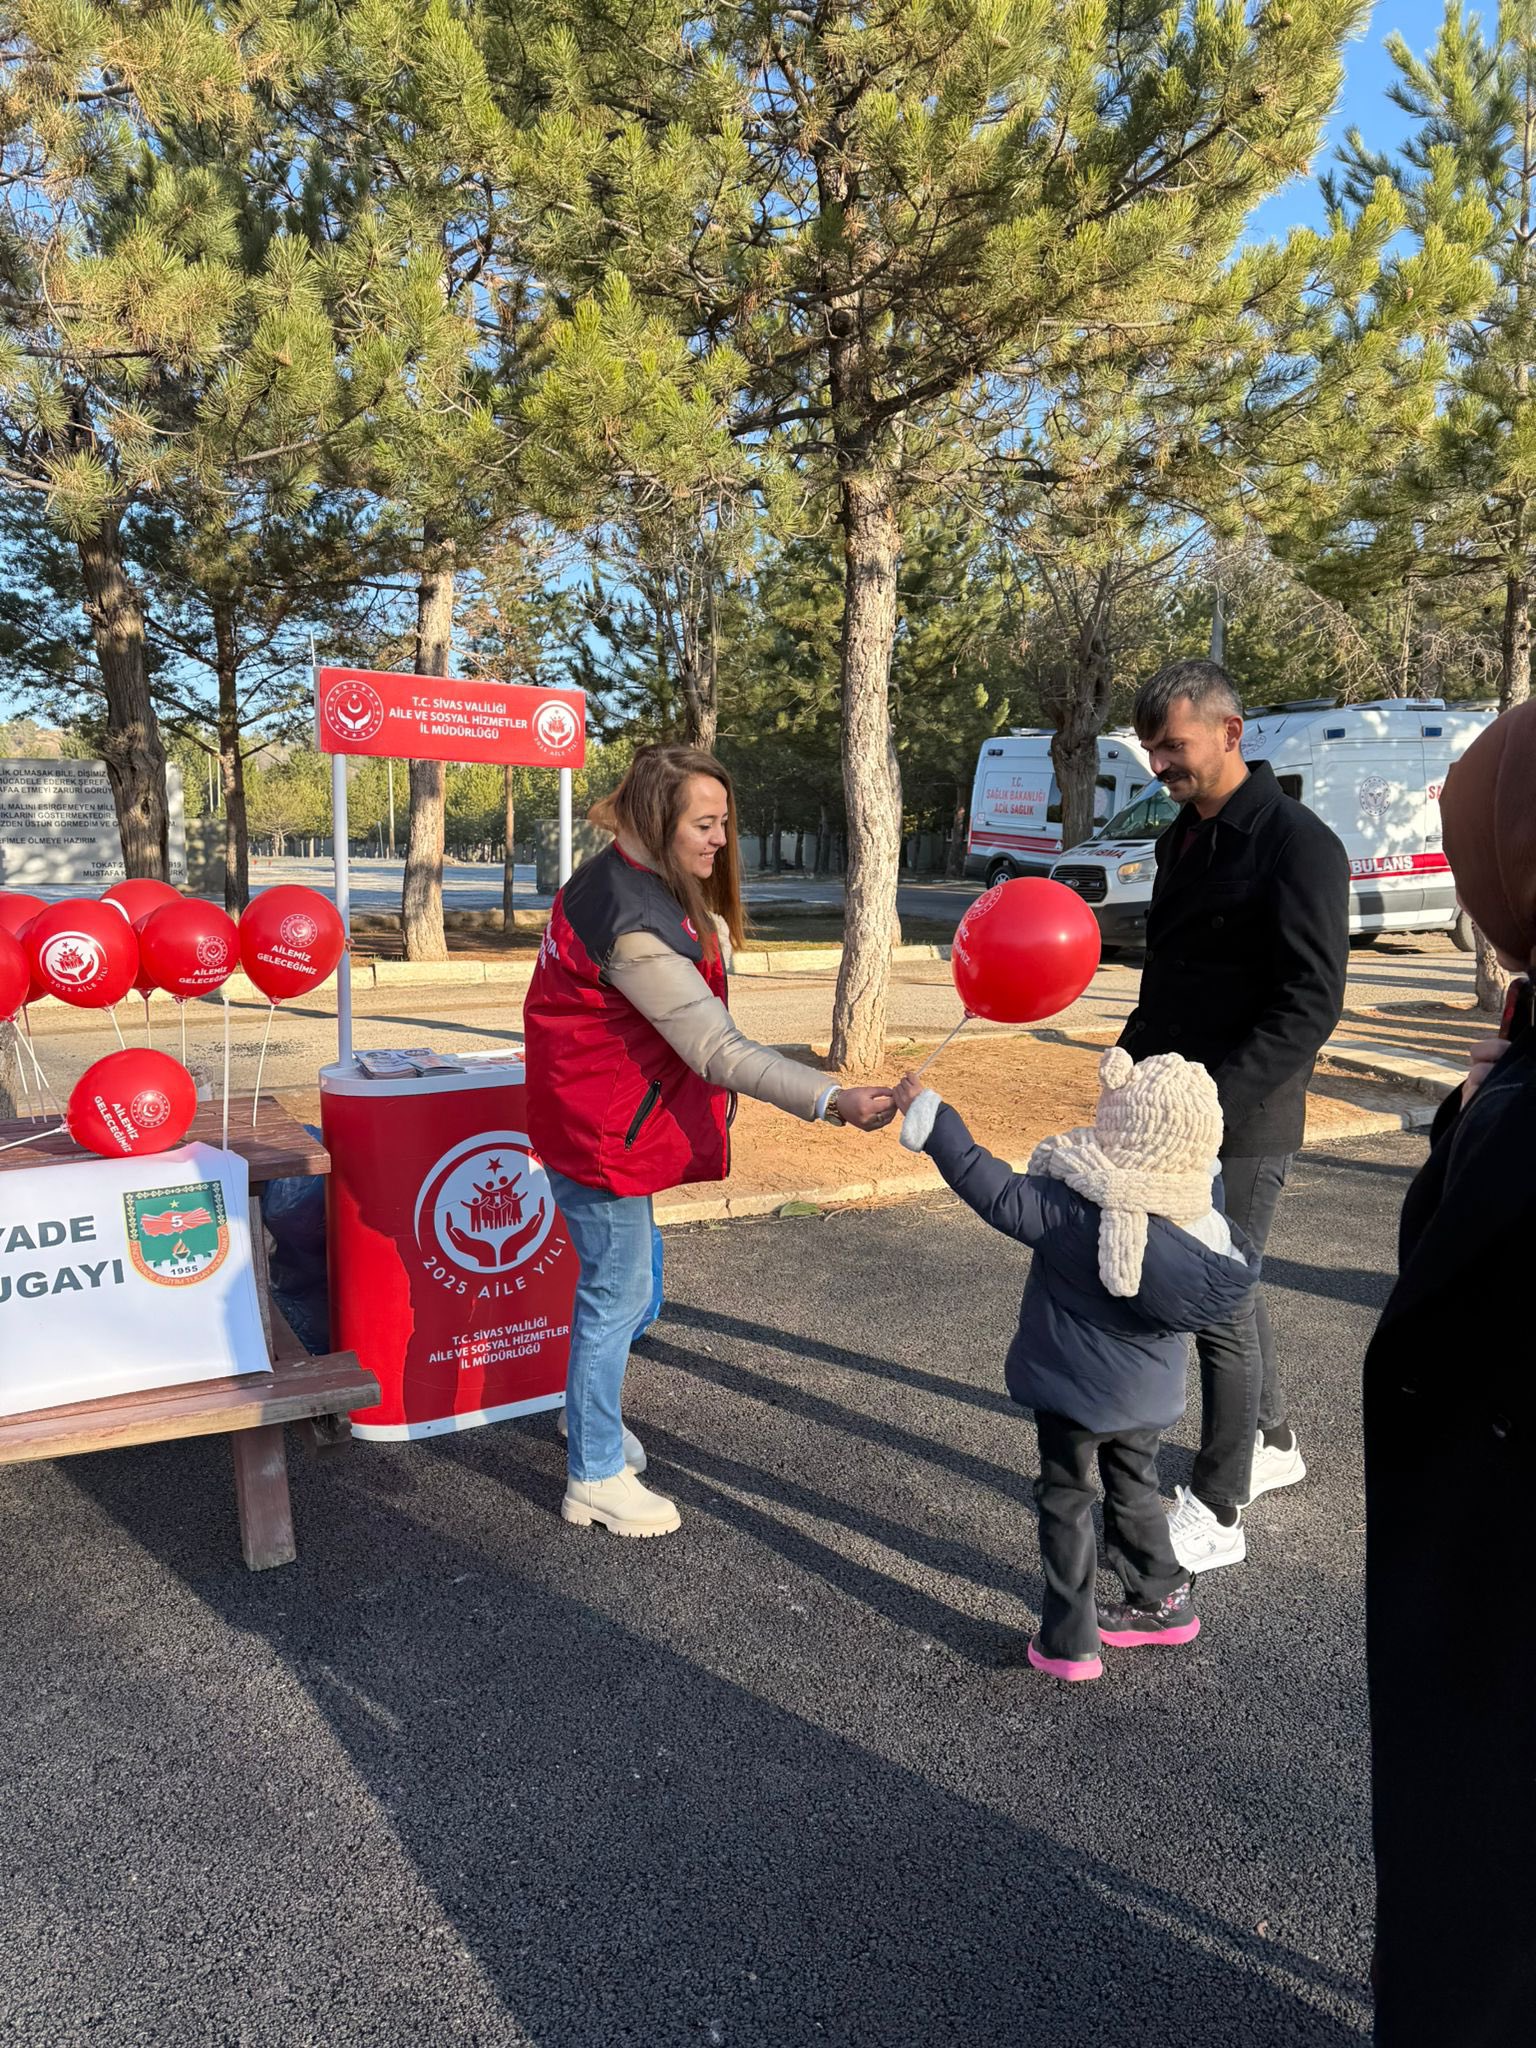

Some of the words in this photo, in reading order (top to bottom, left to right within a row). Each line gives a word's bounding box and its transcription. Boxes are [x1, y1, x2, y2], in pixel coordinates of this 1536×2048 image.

[412, 696, 430, 708] T.C.
[433, 698, 462, 711] SİVAS
[465, 700, 507, 715] VALİLİĞİ
[389, 706, 412, 719] AİLE
[414, 709, 428, 720] VE
[431, 712, 469, 724] SOSYAL
[472, 714, 527, 729] HİZMETLER
[420, 723, 429, 734] İL
[431, 723, 499, 740] MÜDÜRLÜĞÜ
[256, 952, 318, 975] GELECEĞİMİZ
[271, 944, 312, 962] AİLEMİZ
[193, 966, 228, 976] AİLEMİZ
[94, 1095, 132, 1153] GELECEĞİMİZ
[112, 1103, 139, 1140] AİLEMİZ
[171, 1215, 183, 1228] 5
[0, 1215, 97, 1253] ADE
[170, 1265, 199, 1276] 1955
[423, 1256, 468, 1295] 2025
[478, 1276, 527, 1299] AİLE
[533, 1237, 567, 1276] YILI
[452, 1334, 471, 1345] T.C.
[474, 1327, 503, 1341] SİVAS
[505, 1316, 548, 1335] VALİLİĞİ
[429, 1350, 453, 1363] AİLE
[454, 1347, 469, 1358] VE
[471, 1340, 510, 1355] SOSYAL
[512, 1325, 569, 1346] HİZMETLER
[461, 1357, 471, 1369] İL
[472, 1342, 541, 1367] MÜDÜRLÜĞÜ
